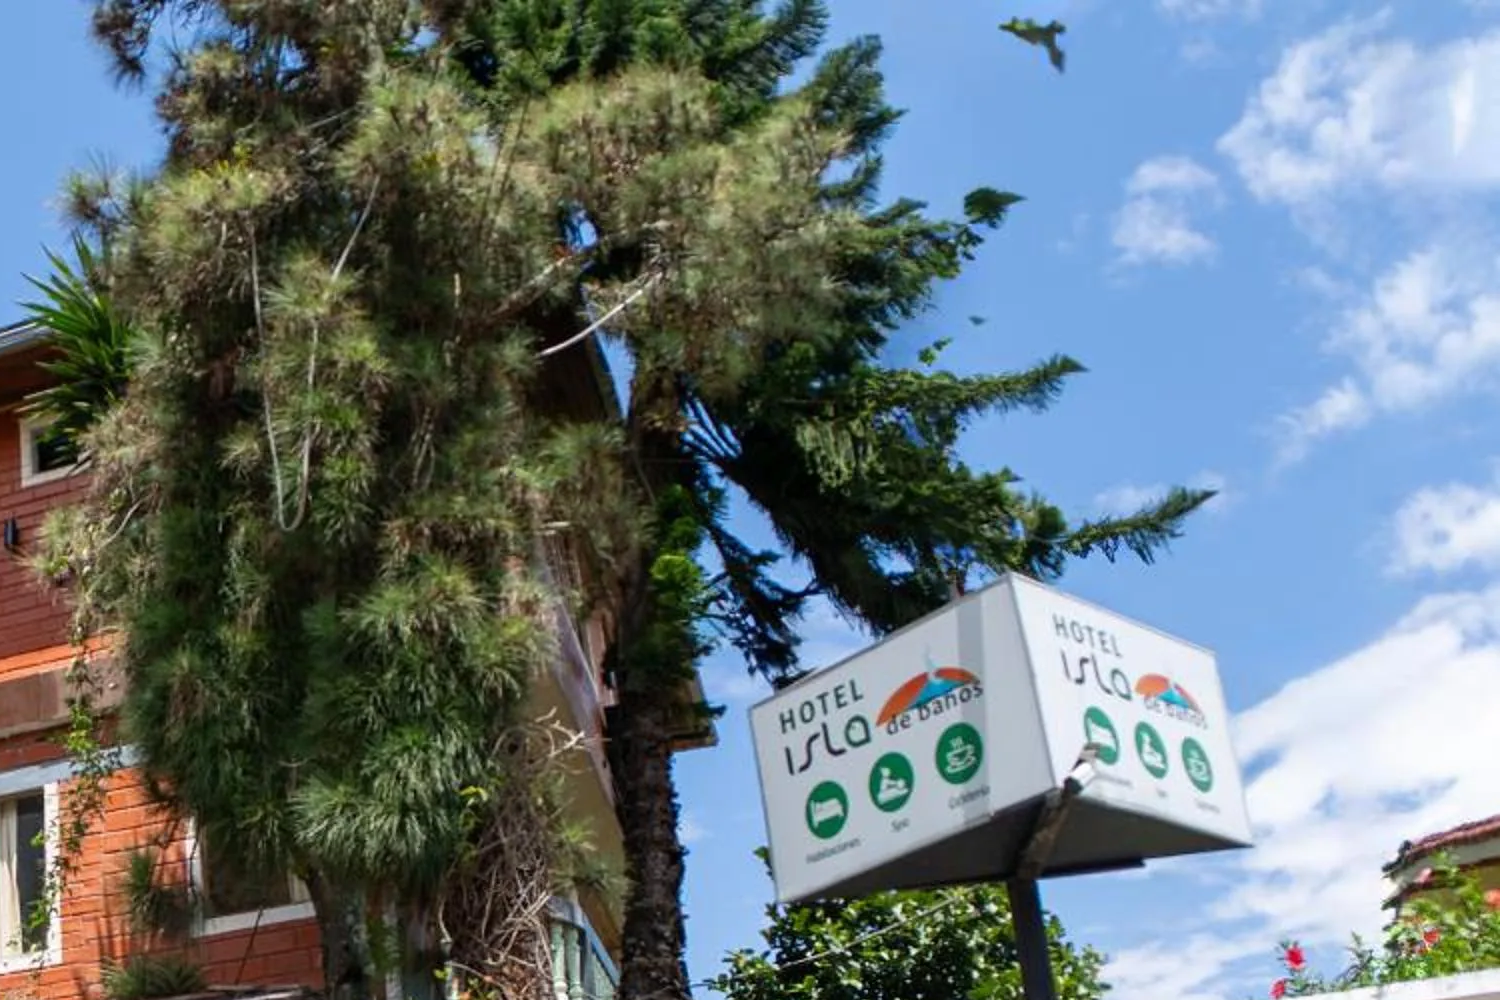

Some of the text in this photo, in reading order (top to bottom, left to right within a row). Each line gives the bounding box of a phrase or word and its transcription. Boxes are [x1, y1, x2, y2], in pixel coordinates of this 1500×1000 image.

[1053, 613, 1122, 658] HOTEL
[778, 679, 864, 734] HOTEL
[886, 712, 911, 735] de
